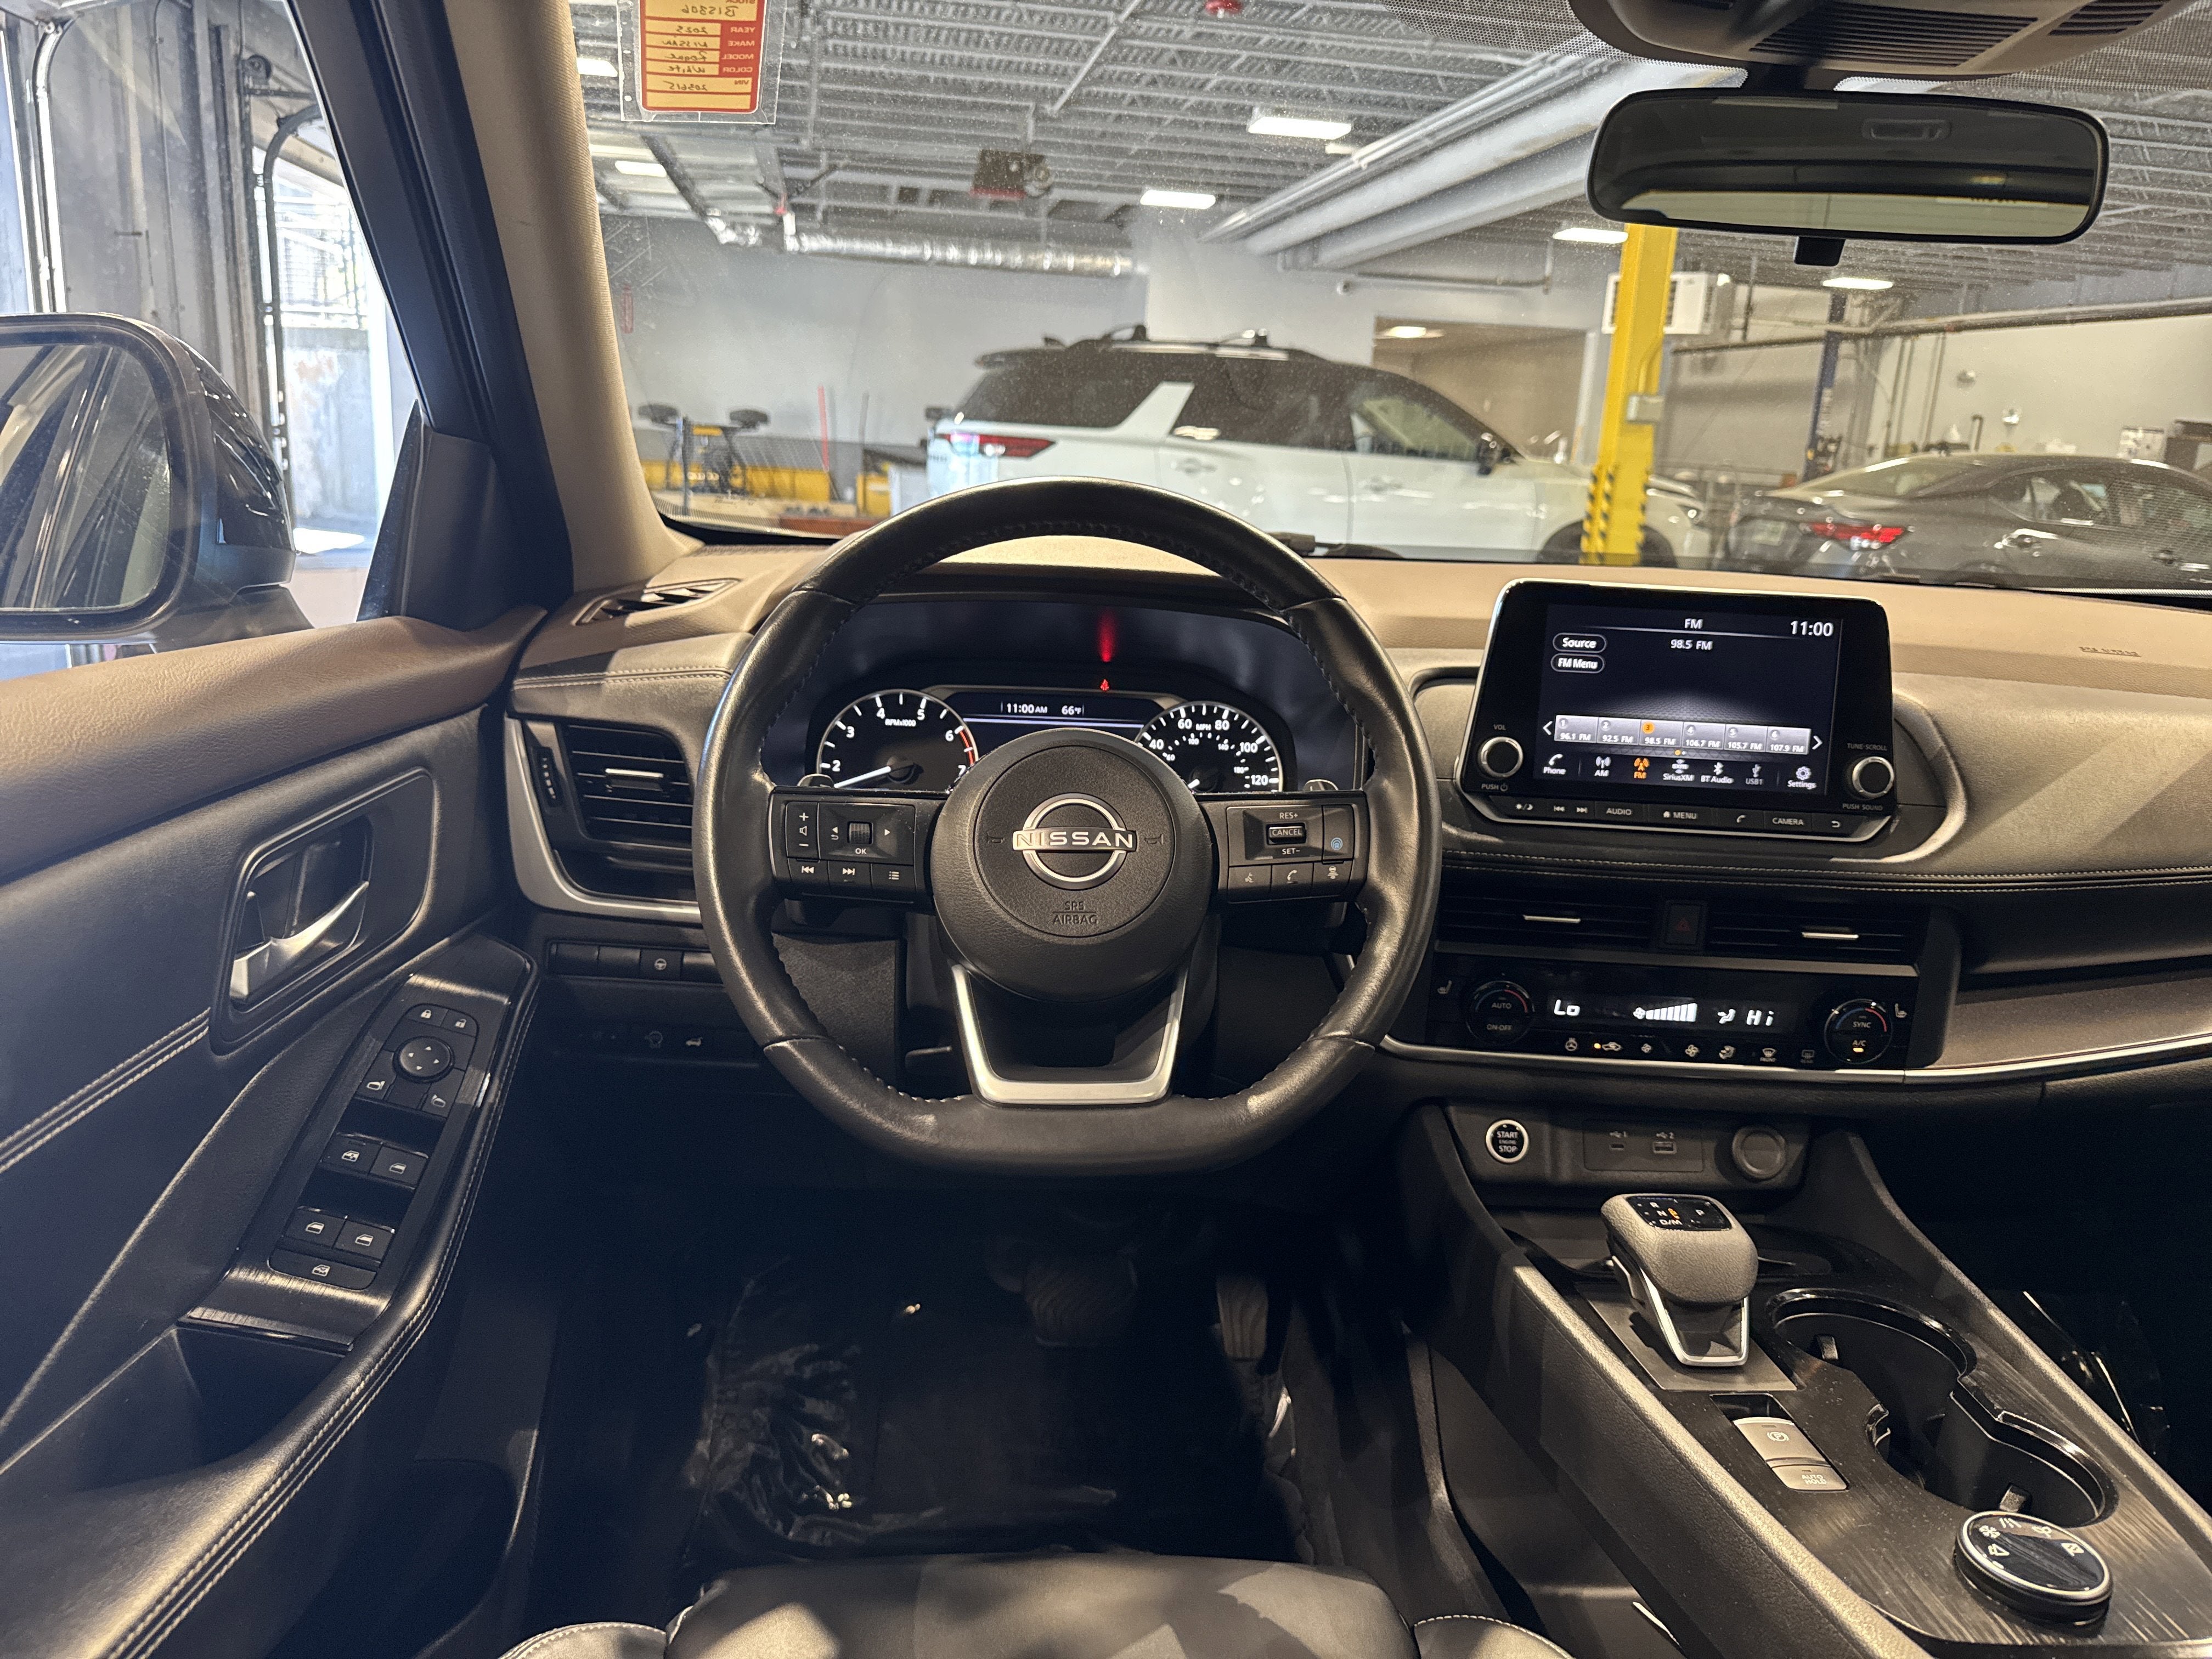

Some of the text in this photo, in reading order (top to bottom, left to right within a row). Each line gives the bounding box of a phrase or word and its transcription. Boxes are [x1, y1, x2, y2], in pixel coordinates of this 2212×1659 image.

[1684, 618, 1703, 629] FM
[1791, 620, 1833, 636] 11:00
[1562, 637, 1597, 648] Source
[1671, 639, 1713, 650] 98.5 FM
[1558, 658, 1598, 669] FM Menu
[877, 708, 885, 719] 4
[917, 709, 925, 720] 5
[1178, 718, 1192, 730] 60
[1215, 720, 1229, 731] 80
[847, 726, 855, 738] 3
[945, 730, 953, 741] 6
[1560, 732, 1576, 741] 96.1
[1149, 739, 1164, 749] 40
[1602, 735, 1618, 743] 92.5
[1645, 737, 1661, 745] 98.5
[1685, 740, 1706, 748] 106.7
[1240, 742, 1258, 753] 100
[832, 760, 840, 772] 2
[958, 765, 966, 776] 7
[1251, 775, 1268, 786] 120
[1663, 773, 1694, 782] SiriusXM
[1712, 776, 1734, 784] Audio
[1787, 780, 1816, 789] Settings
[1606, 808, 1632, 816] AUDIO
[1773, 817, 1803, 826] CAMERA
[1017, 831, 1133, 848] NISSAN
[1065, 901, 1085, 911] SRS
[1053, 915, 1098, 924] AIRBAG
[1554, 999, 1580, 1016] Lo
[1746, 1009, 1774, 1026] Hi
